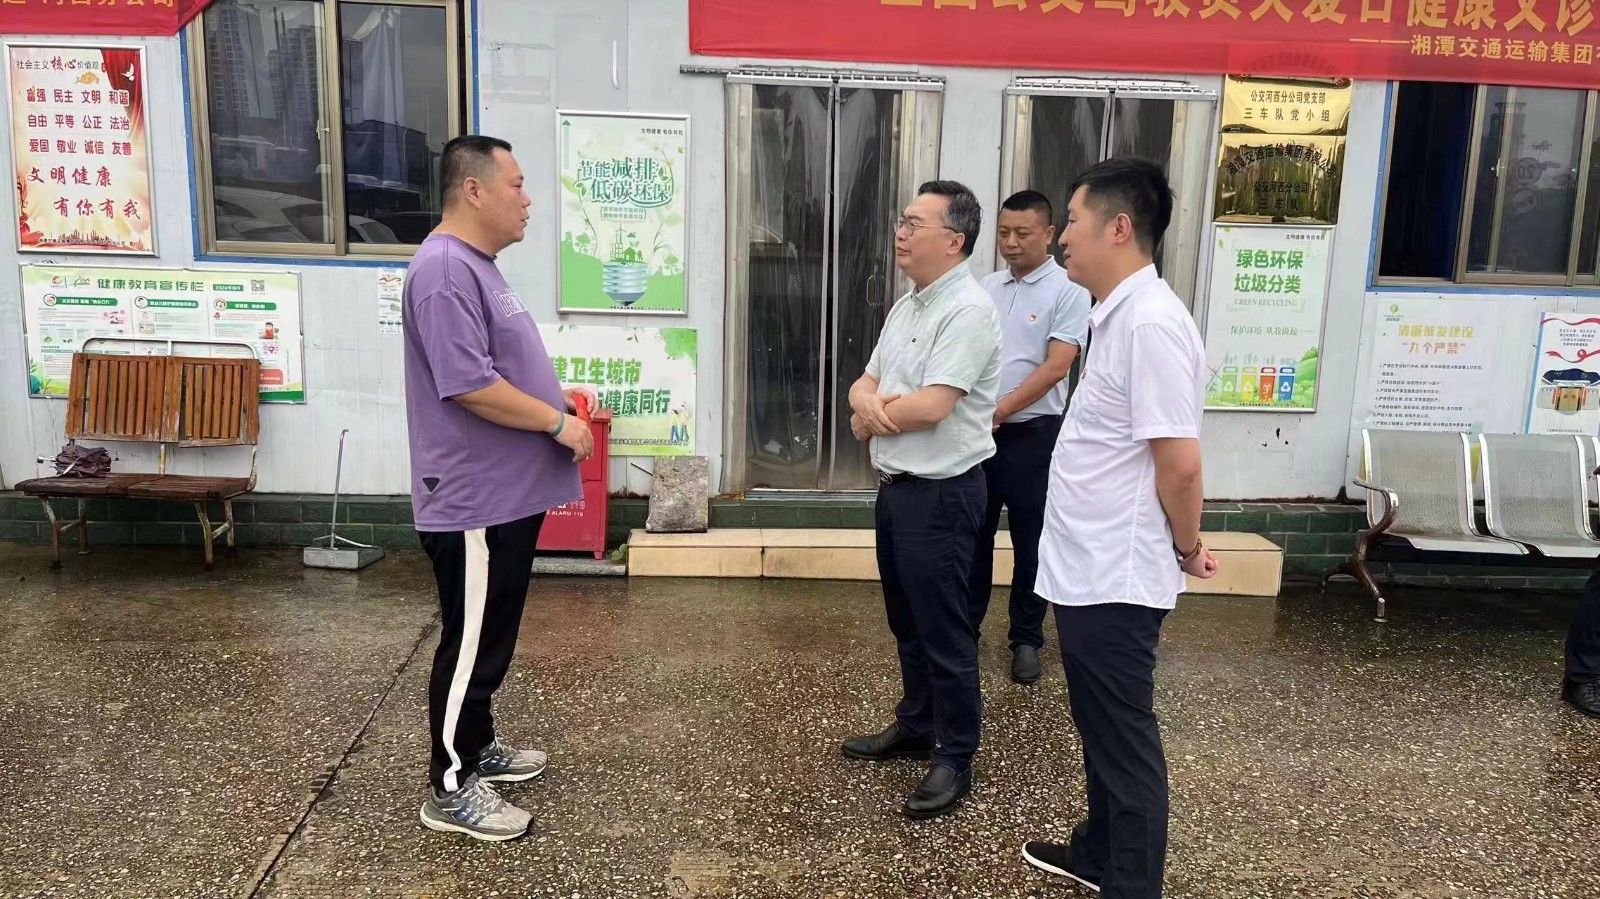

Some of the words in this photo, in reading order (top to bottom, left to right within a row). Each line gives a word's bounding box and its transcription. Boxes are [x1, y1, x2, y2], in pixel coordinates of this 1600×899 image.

[1350, 34, 1600, 65] ——湘潭交通运输集团
[17, 56, 99, 71] 社会主义核心价值观
[27, 86, 46, 103] 富强
[54, 89, 74, 103] 民主
[81, 90, 101, 104] 文明
[109, 91, 129, 105] 和谐
[1250, 90, 1326, 104] 公交河西分公司党支部
[28, 114, 48, 128] 自由
[55, 114, 74, 129] 平等
[82, 115, 102, 129] 公正
[110, 116, 130, 130] 法治
[1244, 107, 1330, 122] 三车队党小组
[29, 139, 49, 153] 爱国
[57, 139, 77, 153] 敬业
[84, 140, 104, 154] 诚信
[112, 142, 132, 155] 友善
[581, 157, 653, 181] 节能减排
[1225, 143, 1338, 178] 湘潭交通运输集团有限公司
[27, 166, 111, 188] 文明健康
[591, 179, 669, 201] 低碳环保
[1254, 181, 1309, 193] 公交河西分公司
[53, 197, 141, 220] 有你有我
[1236, 249, 1304, 270] 绿色环保
[98, 278, 204, 292] 健康教育宣传栏
[1234, 274, 1301, 294] 垃圾分类
[1259, 299, 1298, 307] RECYCLING
[1231, 325, 1263, 335] 保护环境
[598, 388, 671, 415] 健康同行
